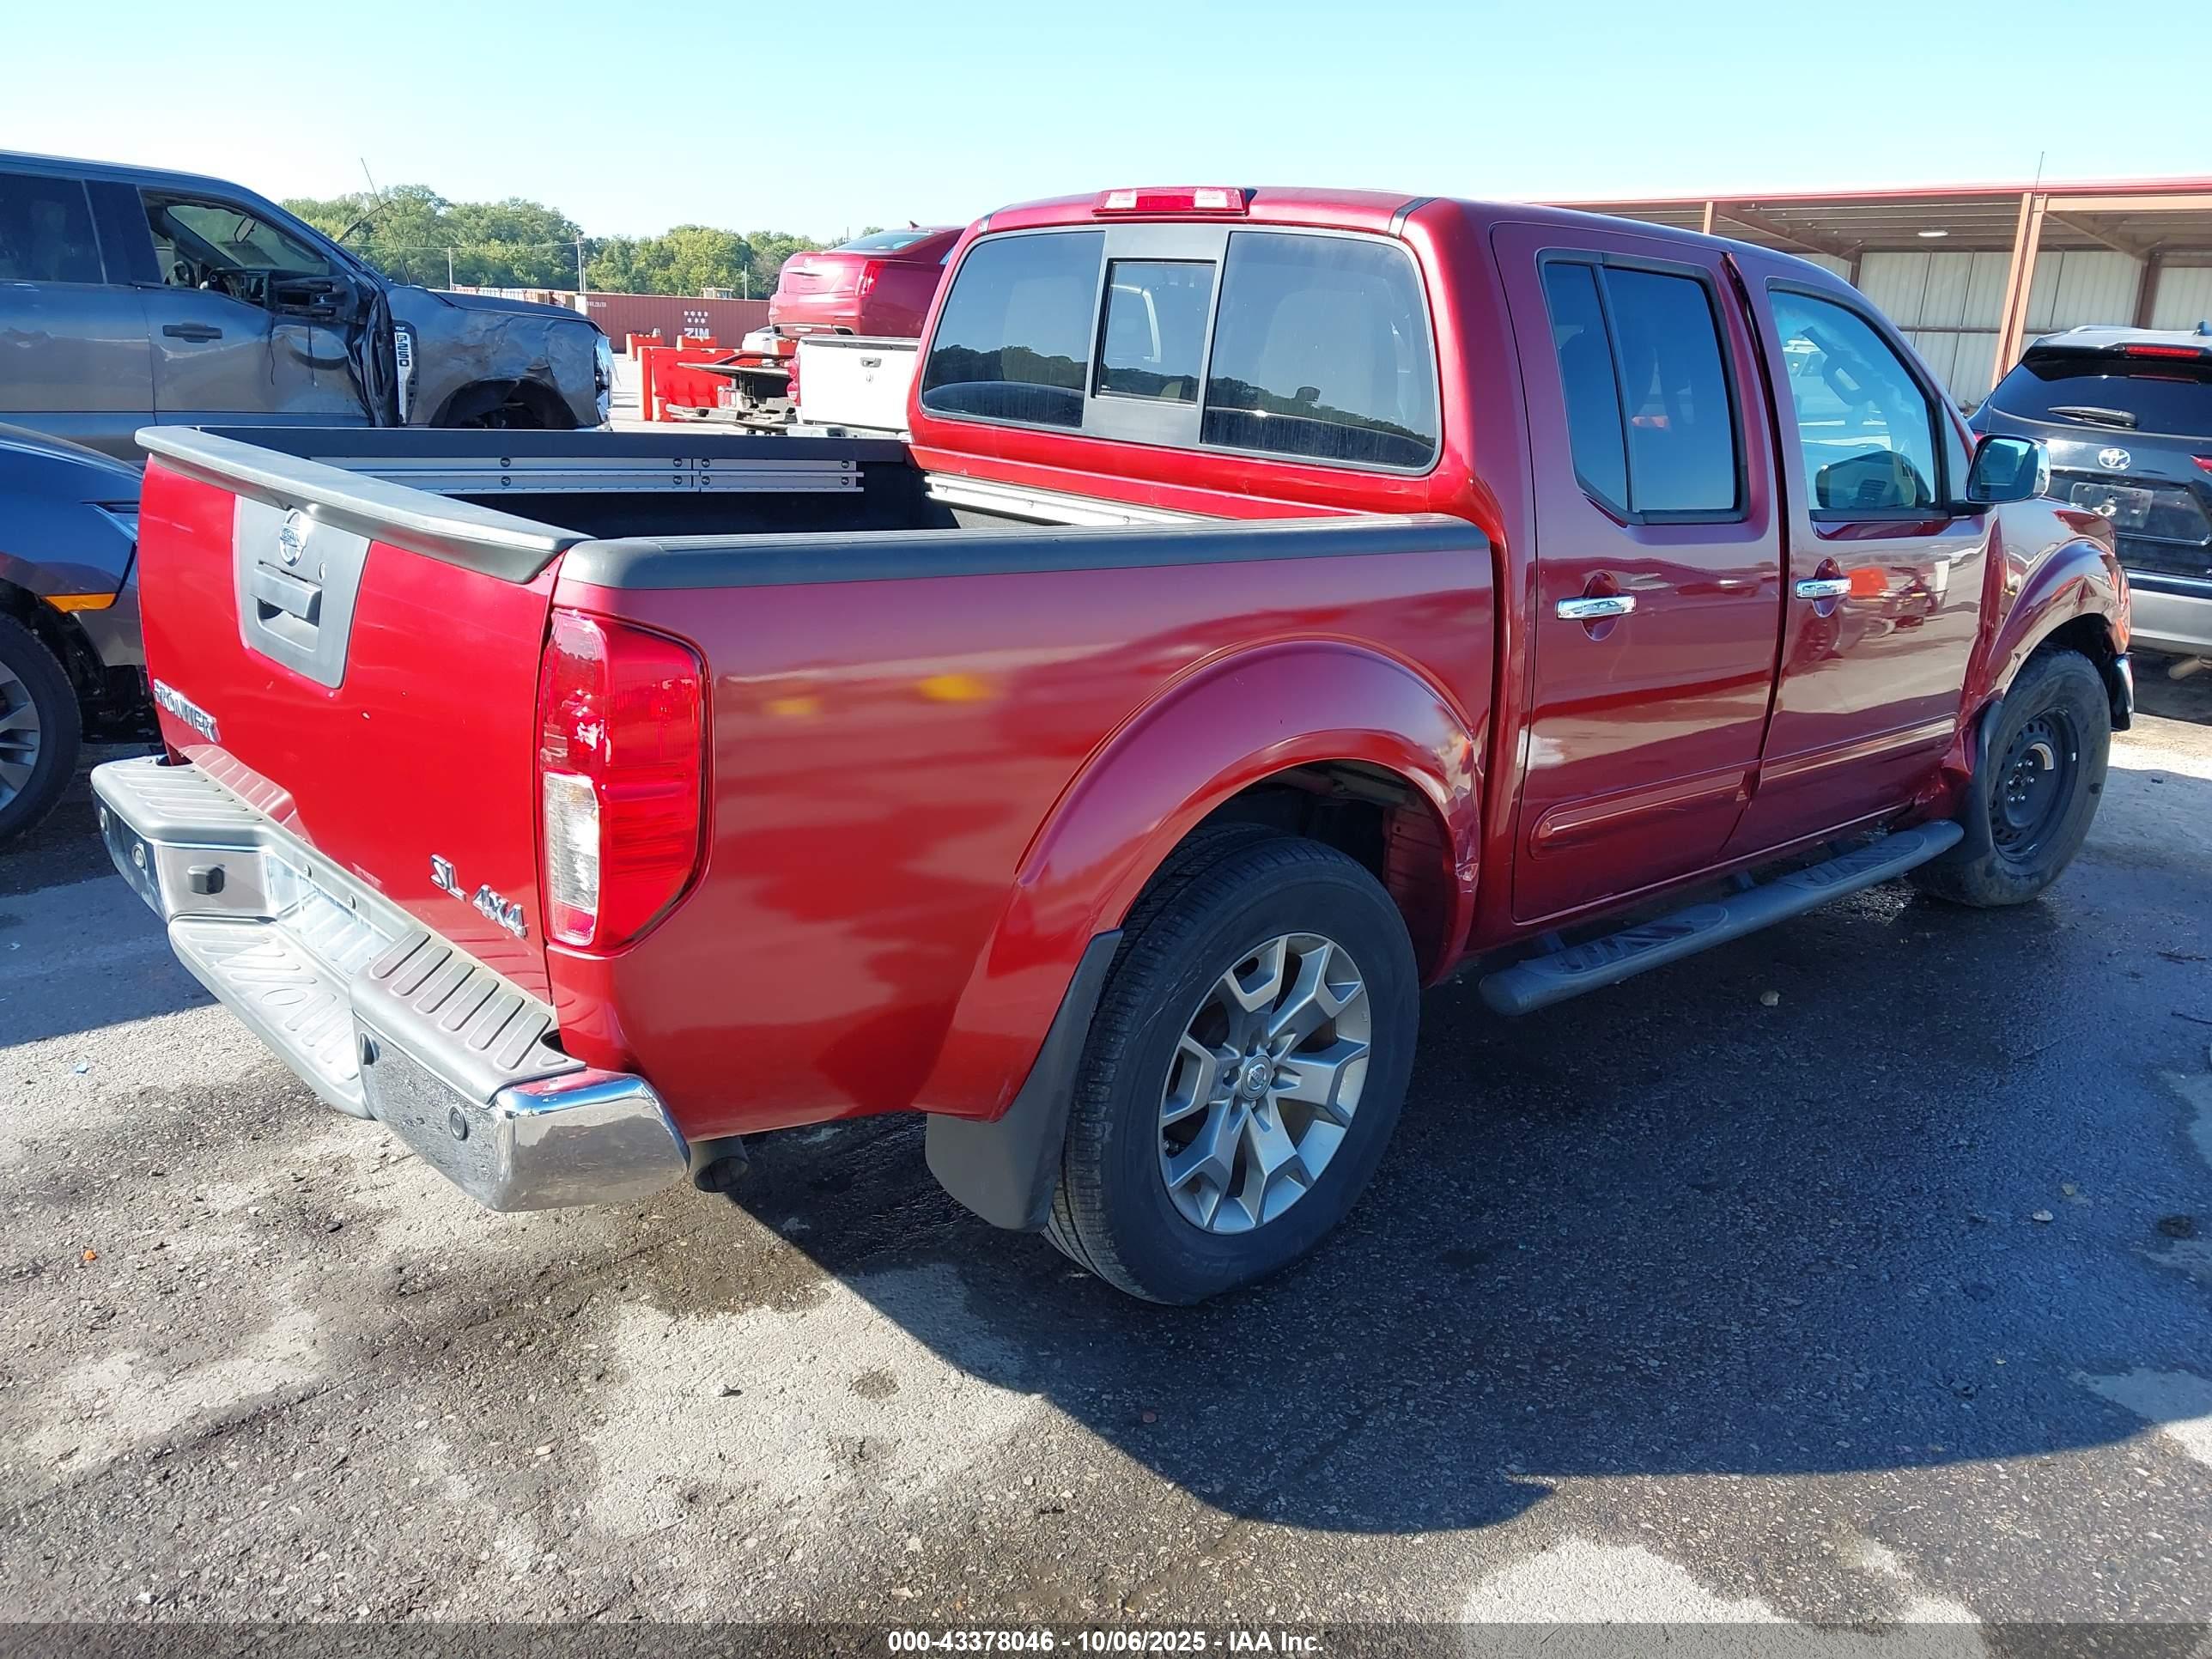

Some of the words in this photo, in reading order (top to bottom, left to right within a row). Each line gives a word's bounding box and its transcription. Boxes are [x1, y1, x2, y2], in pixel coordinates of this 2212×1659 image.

[684, 327, 710, 337] ZIM
[396, 334, 410, 367] F250
[429, 854, 467, 903] SL
